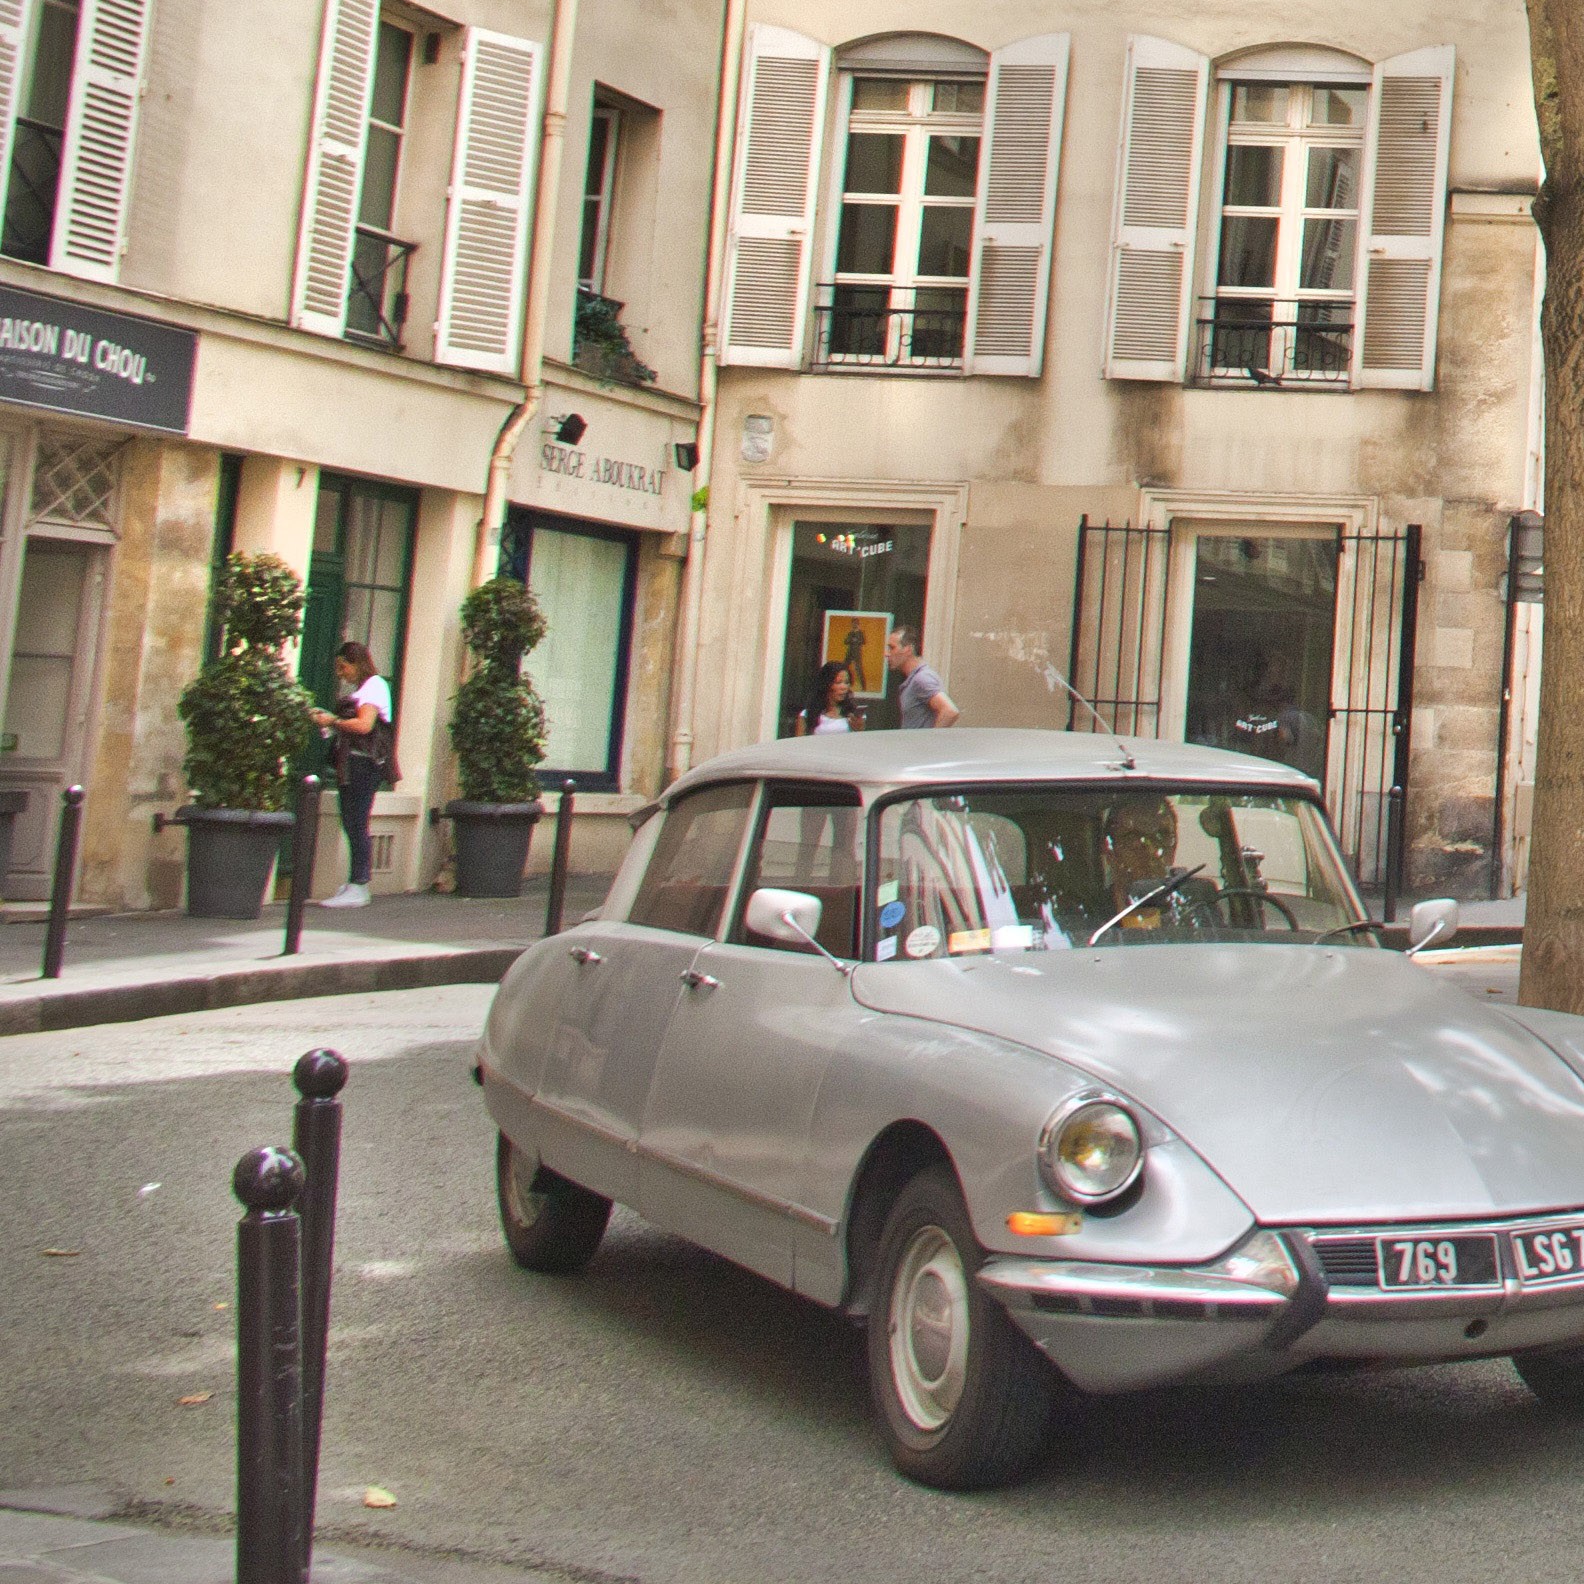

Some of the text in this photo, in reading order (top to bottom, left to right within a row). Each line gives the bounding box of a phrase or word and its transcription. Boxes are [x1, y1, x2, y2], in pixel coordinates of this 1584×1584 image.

[0, 317, 60, 355] AISON
[62, 328, 93, 364] DU
[94, 339, 148, 385] CHOU
[541, 444, 587, 479] SERGE
[590, 457, 666, 496] ABOUKRAT
[861, 540, 893, 558] CUBE
[1393, 1240, 1458, 1283] 769
